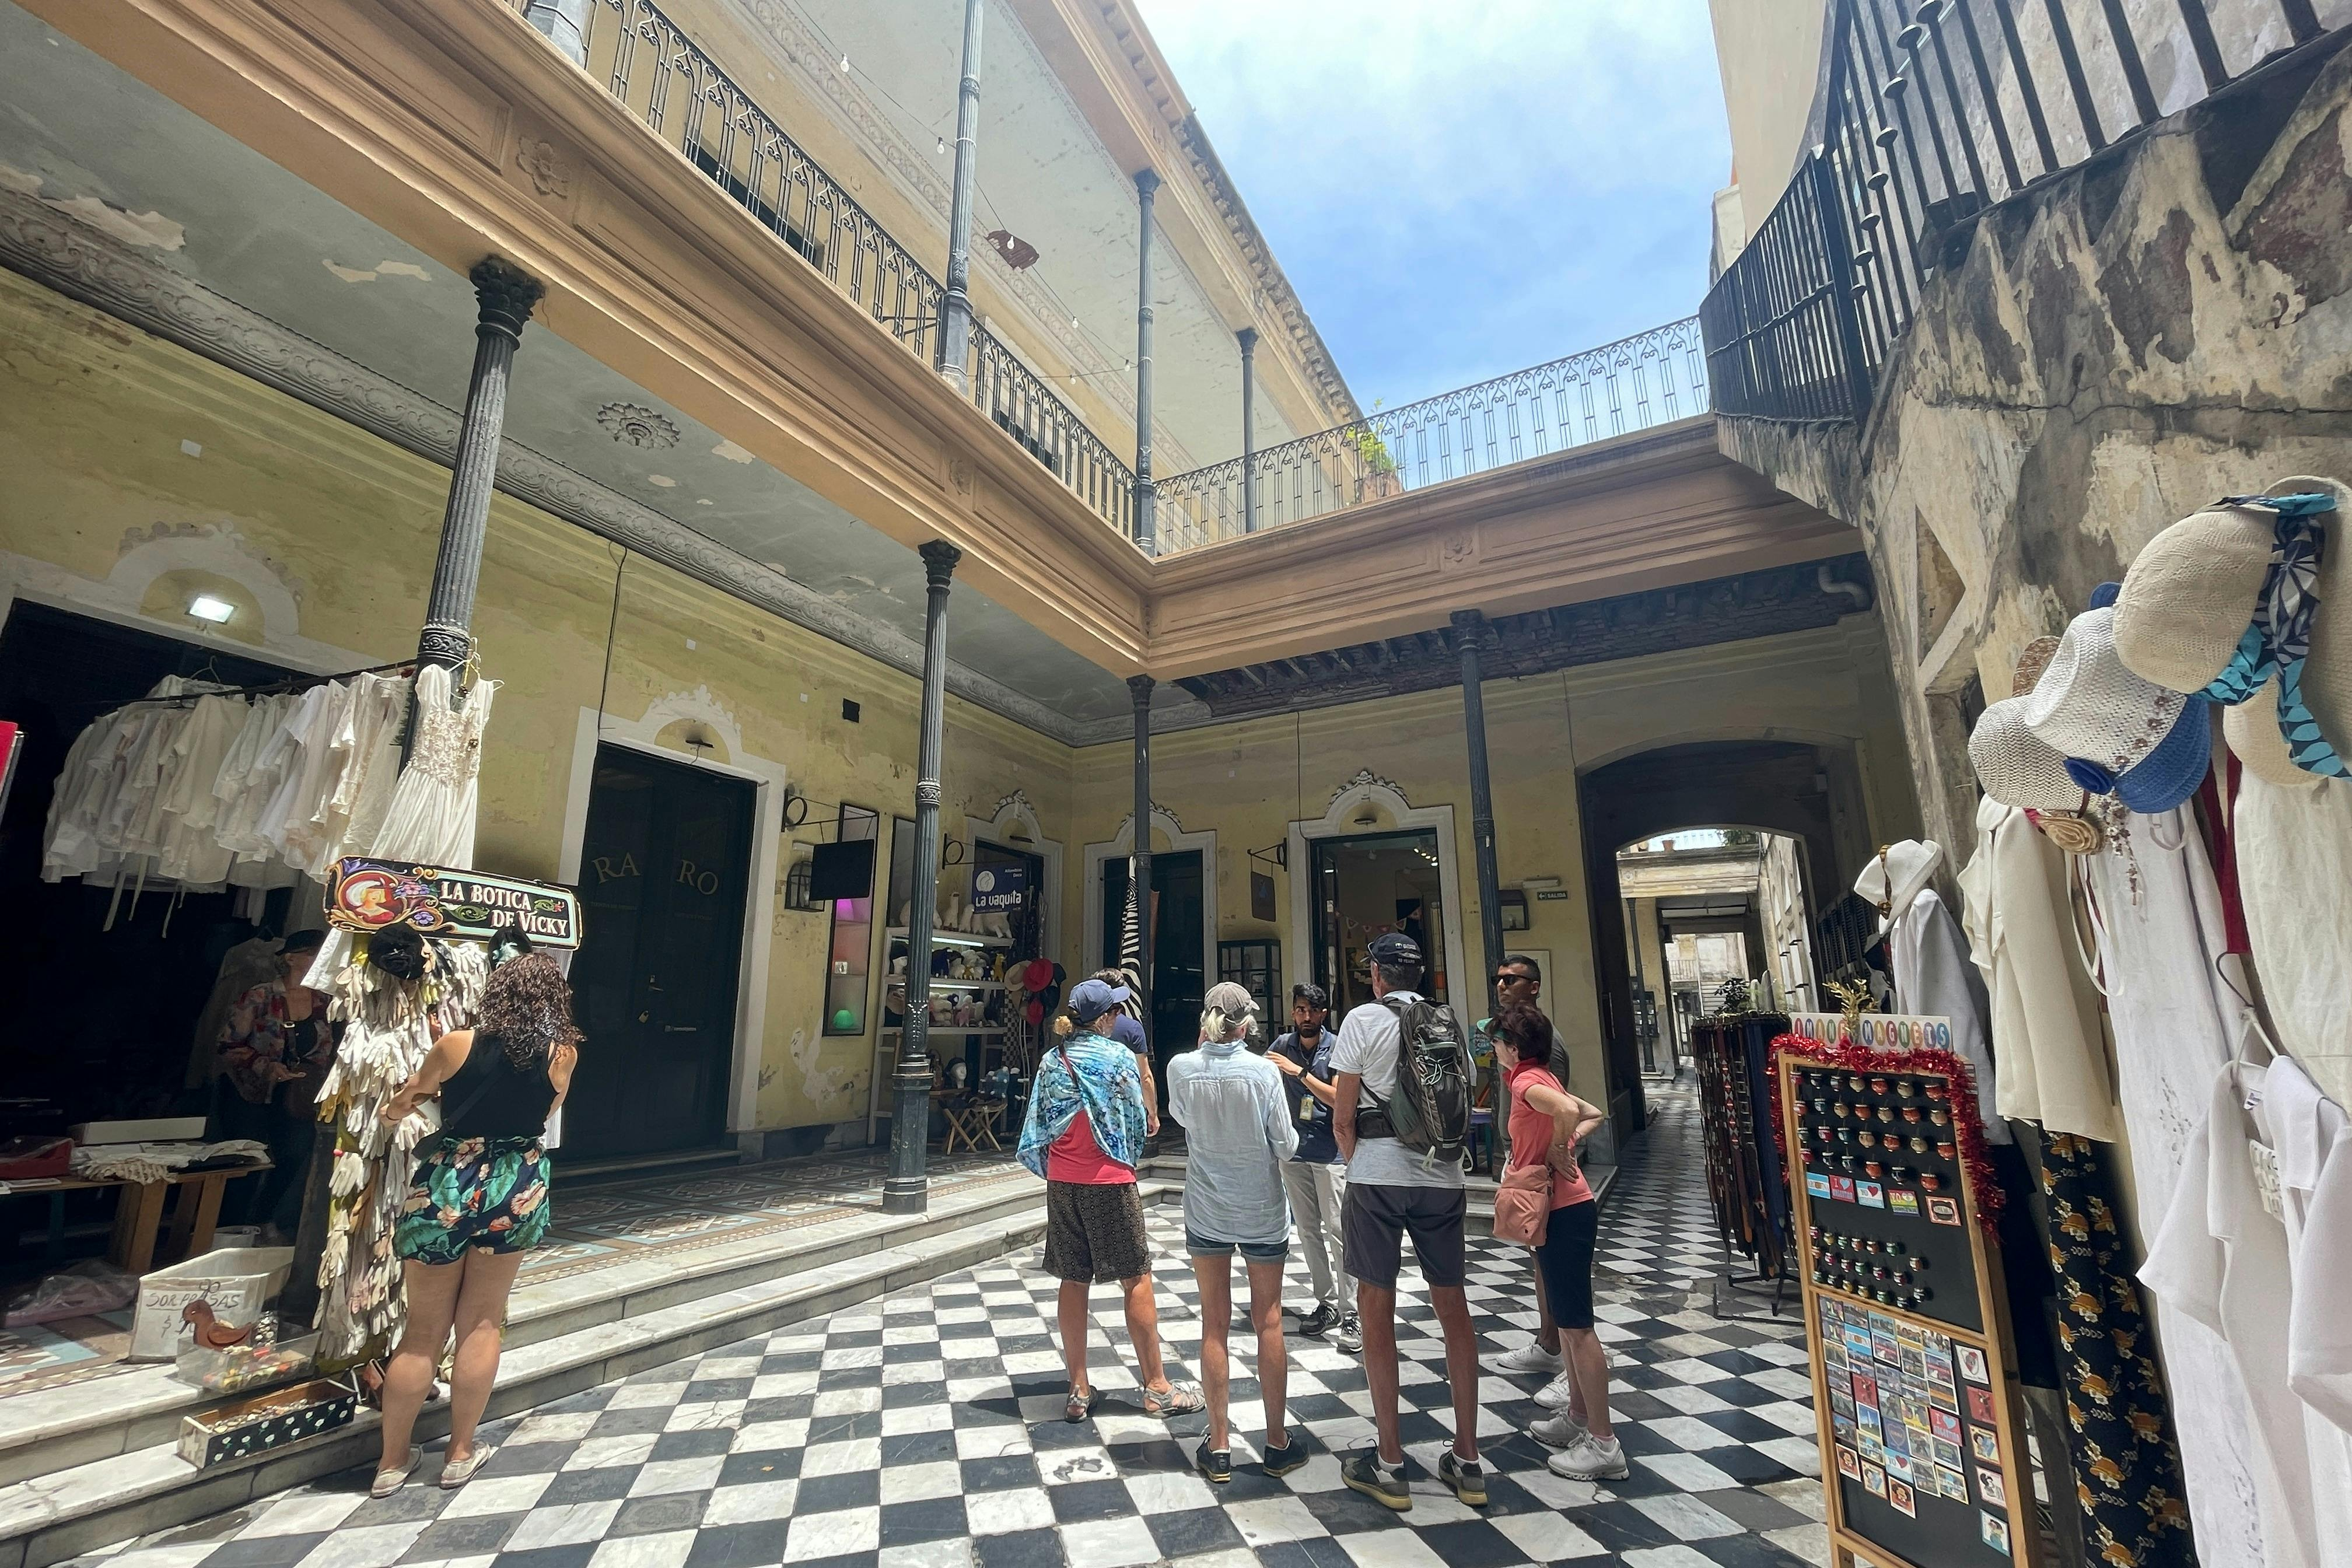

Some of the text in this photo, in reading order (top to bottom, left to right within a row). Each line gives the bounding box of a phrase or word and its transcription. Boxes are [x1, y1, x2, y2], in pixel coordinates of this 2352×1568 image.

[439, 881, 532, 911] LA BOTICA
[988, 890, 1022, 909] vaquita
[1796, 1019, 1948, 1048] IMANE MAGNETS
[146, 1292, 240, 1308] SORPRSAS
